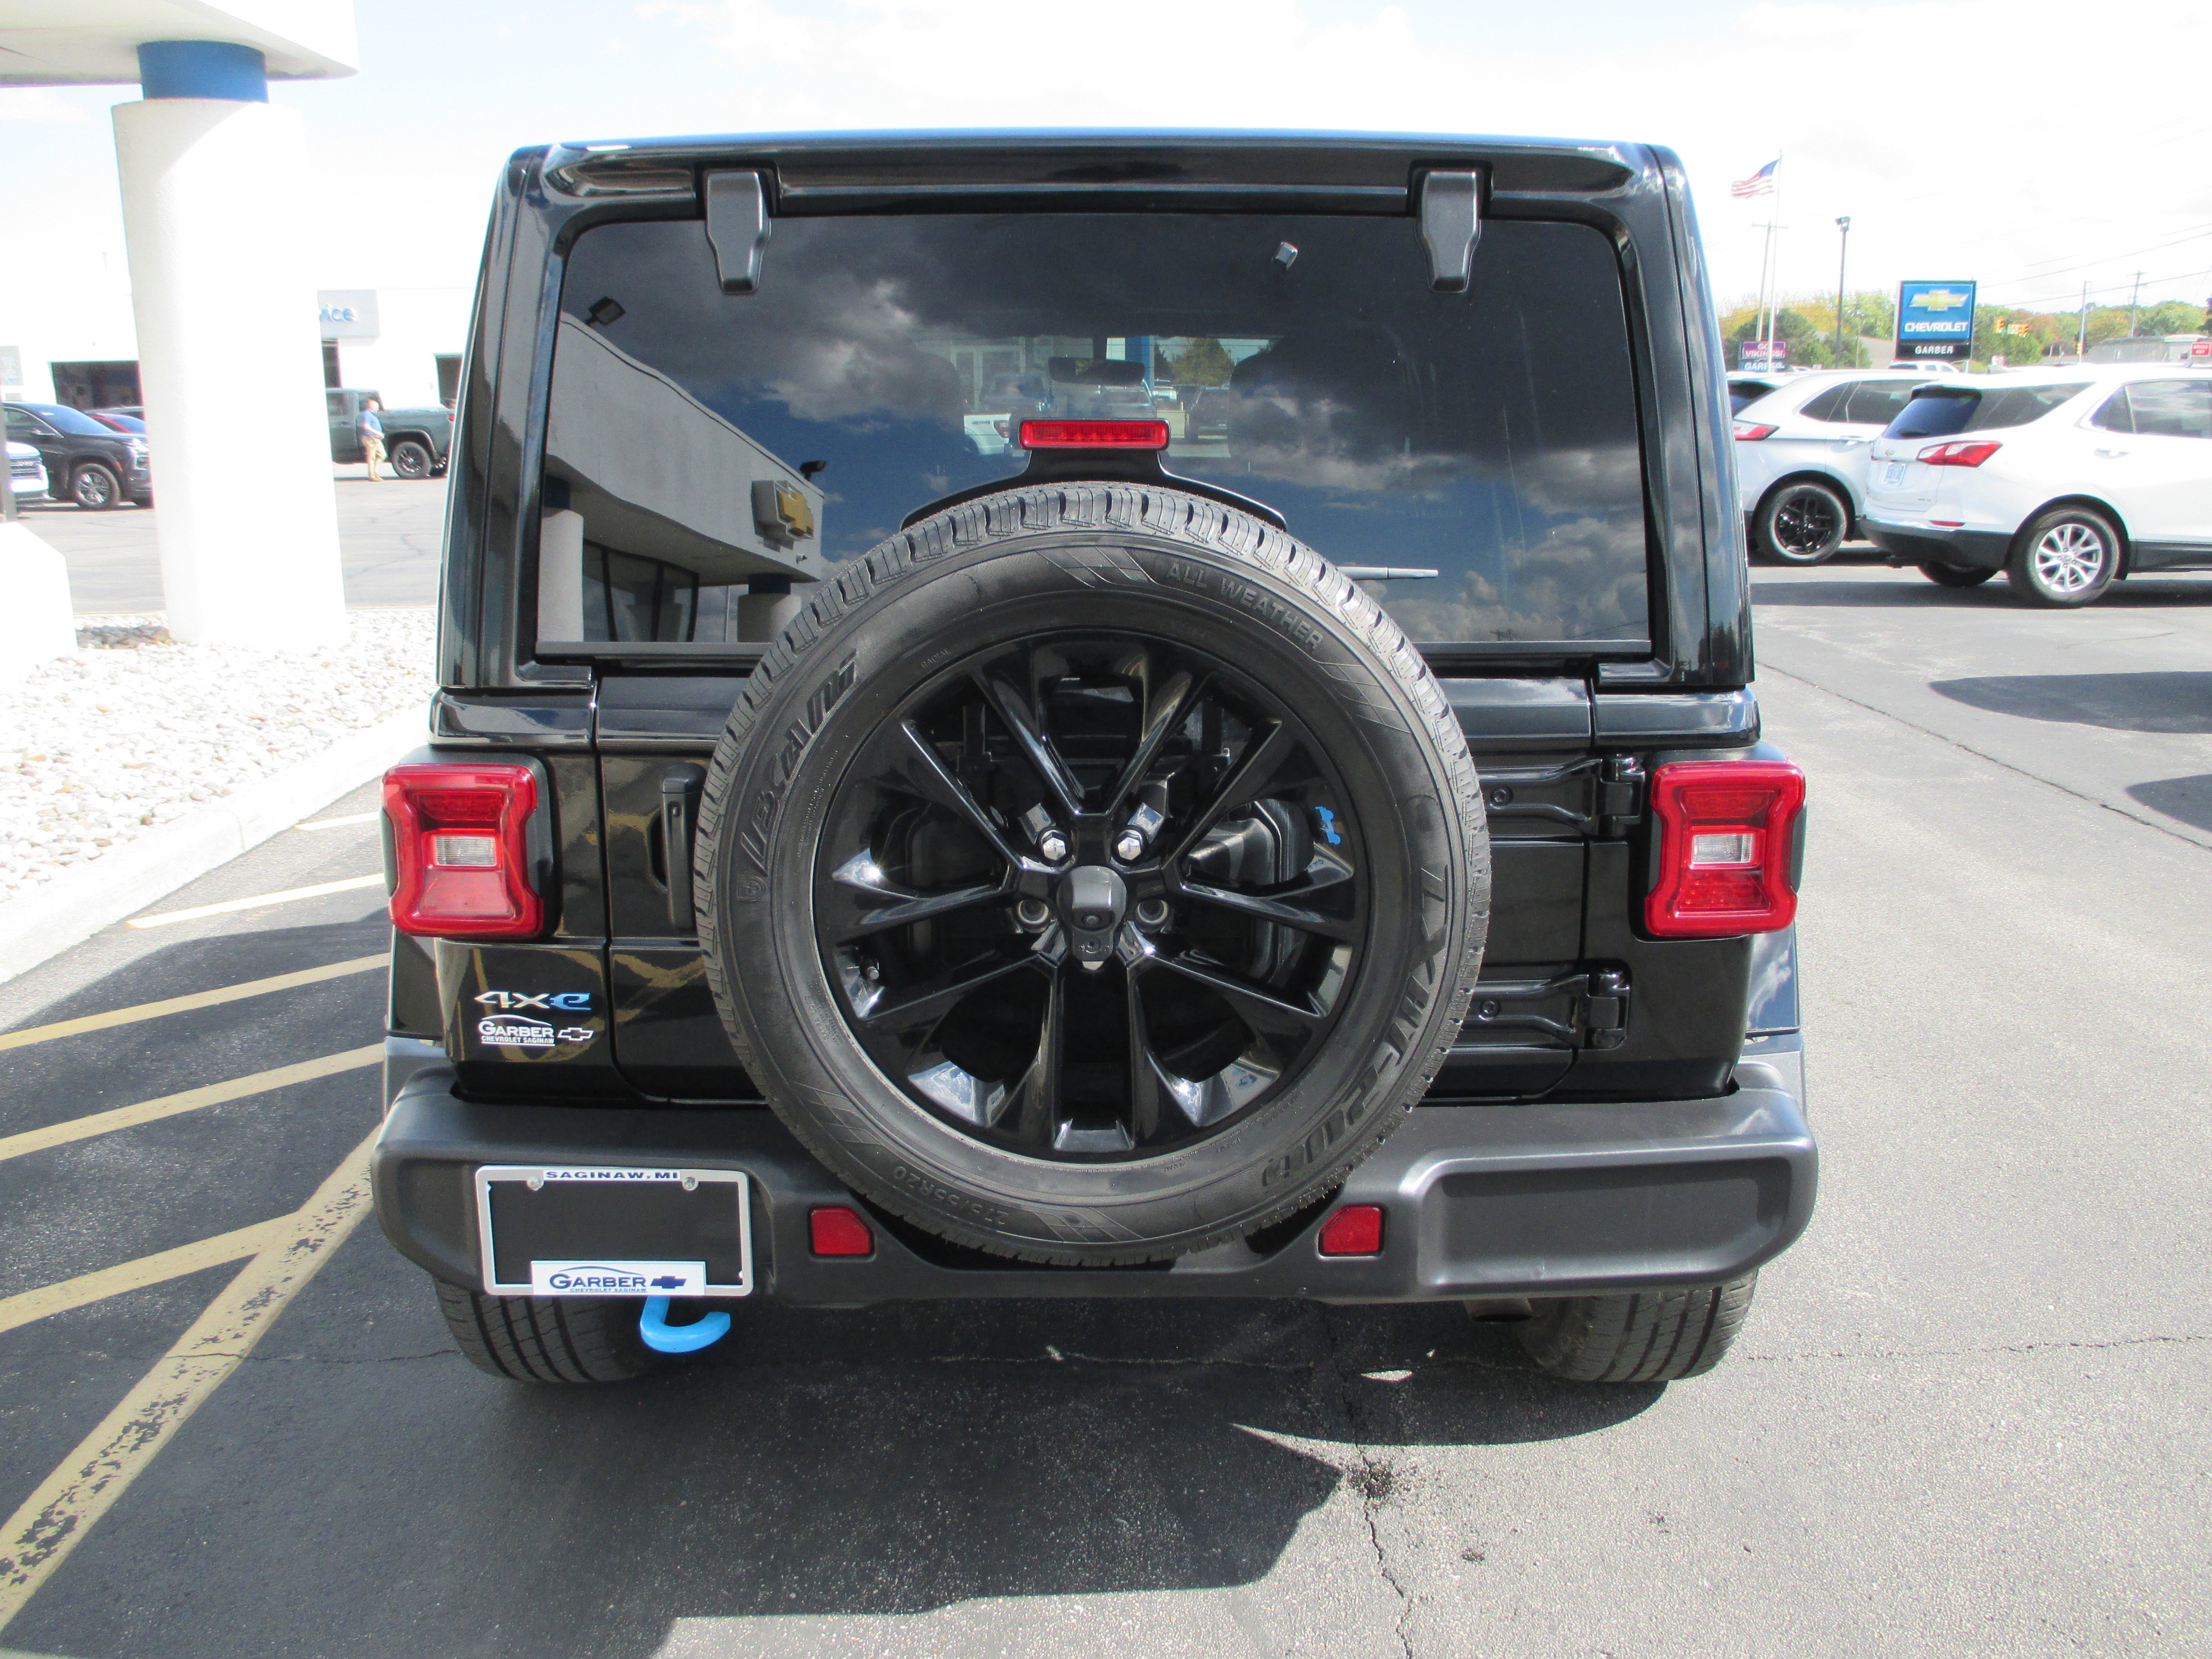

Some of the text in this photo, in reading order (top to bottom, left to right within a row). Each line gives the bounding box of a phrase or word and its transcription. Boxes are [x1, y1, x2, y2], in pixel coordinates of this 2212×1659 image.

[1904, 322, 1968, 332] CHEVROLET
[1914, 345, 1954, 354] GARBER
[1166, 563, 1323, 649] ALL WEATHER
[478, 1020, 555, 1037] GARBER
[892, 1166, 1009, 1225] 275/55R20
[550, 1273, 647, 1289] GARBER
